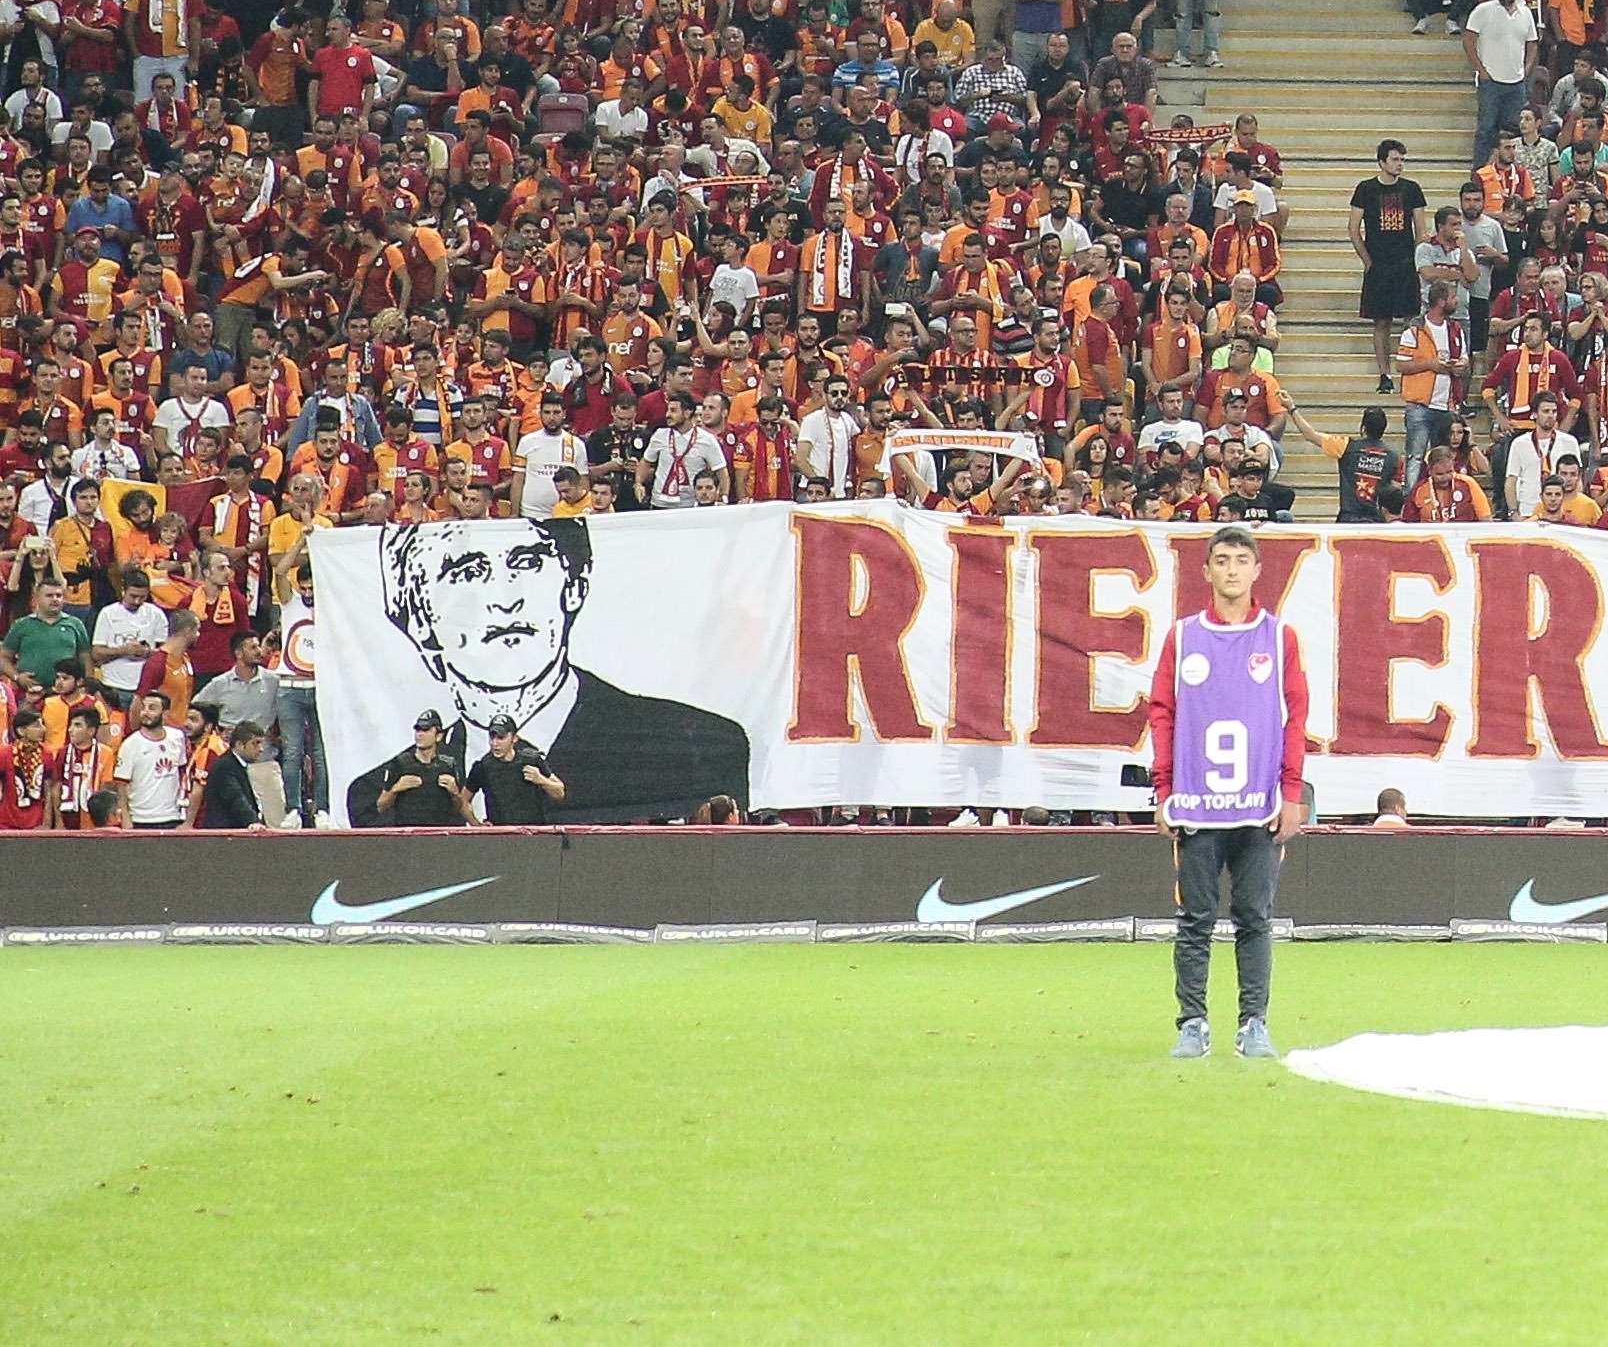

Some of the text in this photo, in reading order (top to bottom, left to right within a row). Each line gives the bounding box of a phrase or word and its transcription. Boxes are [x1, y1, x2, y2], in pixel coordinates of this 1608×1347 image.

[607, 340, 632, 357] nef
[1203, 718, 1248, 794] 9
[1173, 792, 1201, 812] TOP
[200, 924, 325, 940] LUKOILCARD
[365, 923, 488, 939] LUKOILCARD
[691, 924, 811, 939] LUKOILCARD
[1486, 923, 1602, 938] LUKOILCARD
